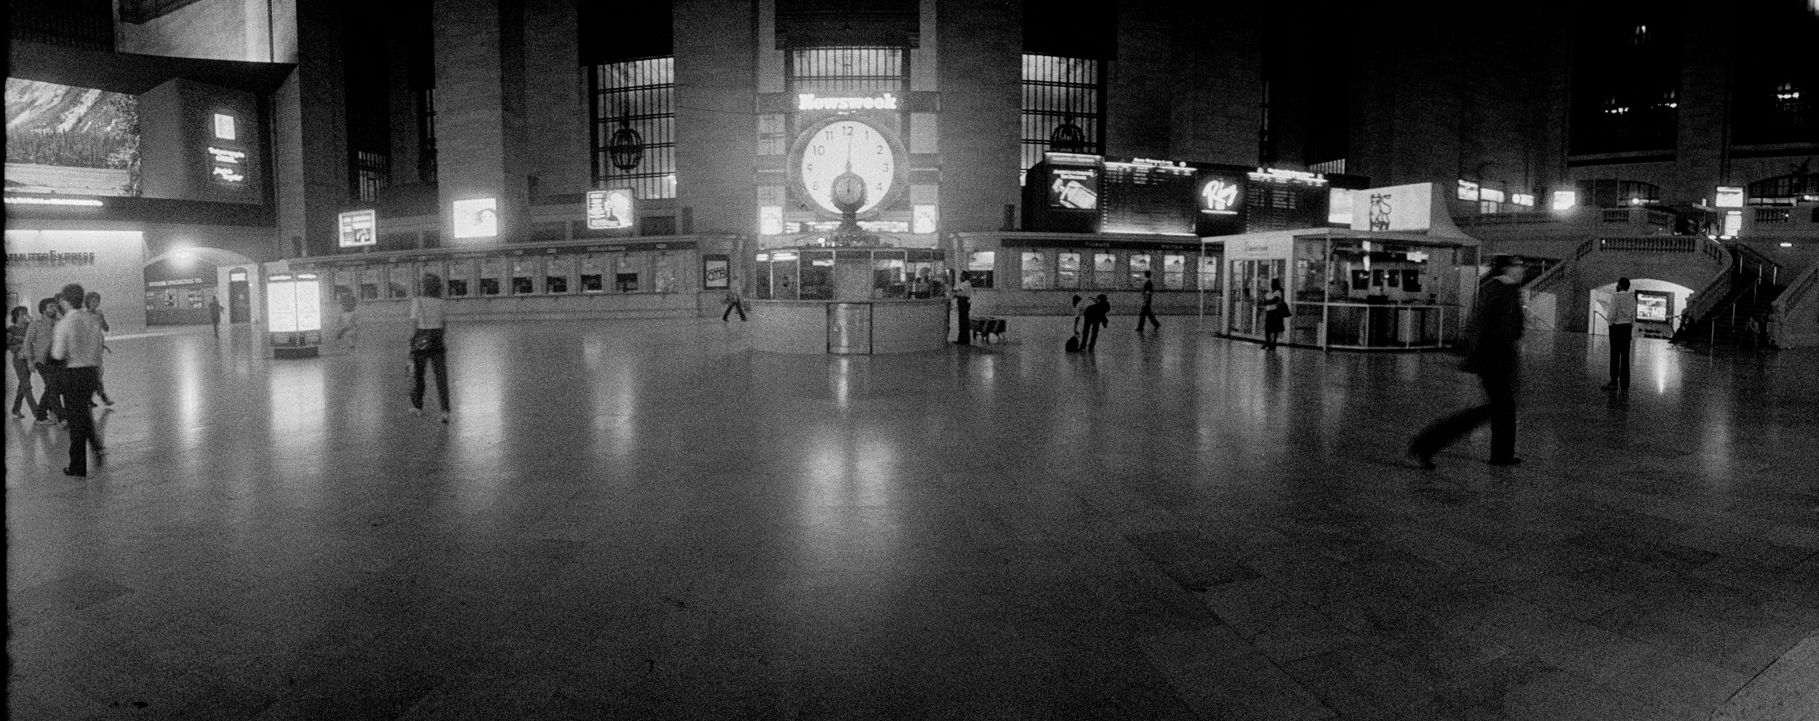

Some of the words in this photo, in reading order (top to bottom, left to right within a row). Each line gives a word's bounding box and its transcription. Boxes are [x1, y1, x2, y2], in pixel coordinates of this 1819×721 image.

[798, 93, 897, 110] Newsweek
[842, 126, 854, 136] 12
[812, 145, 825, 156] 10
[876, 144, 884, 155] 2
